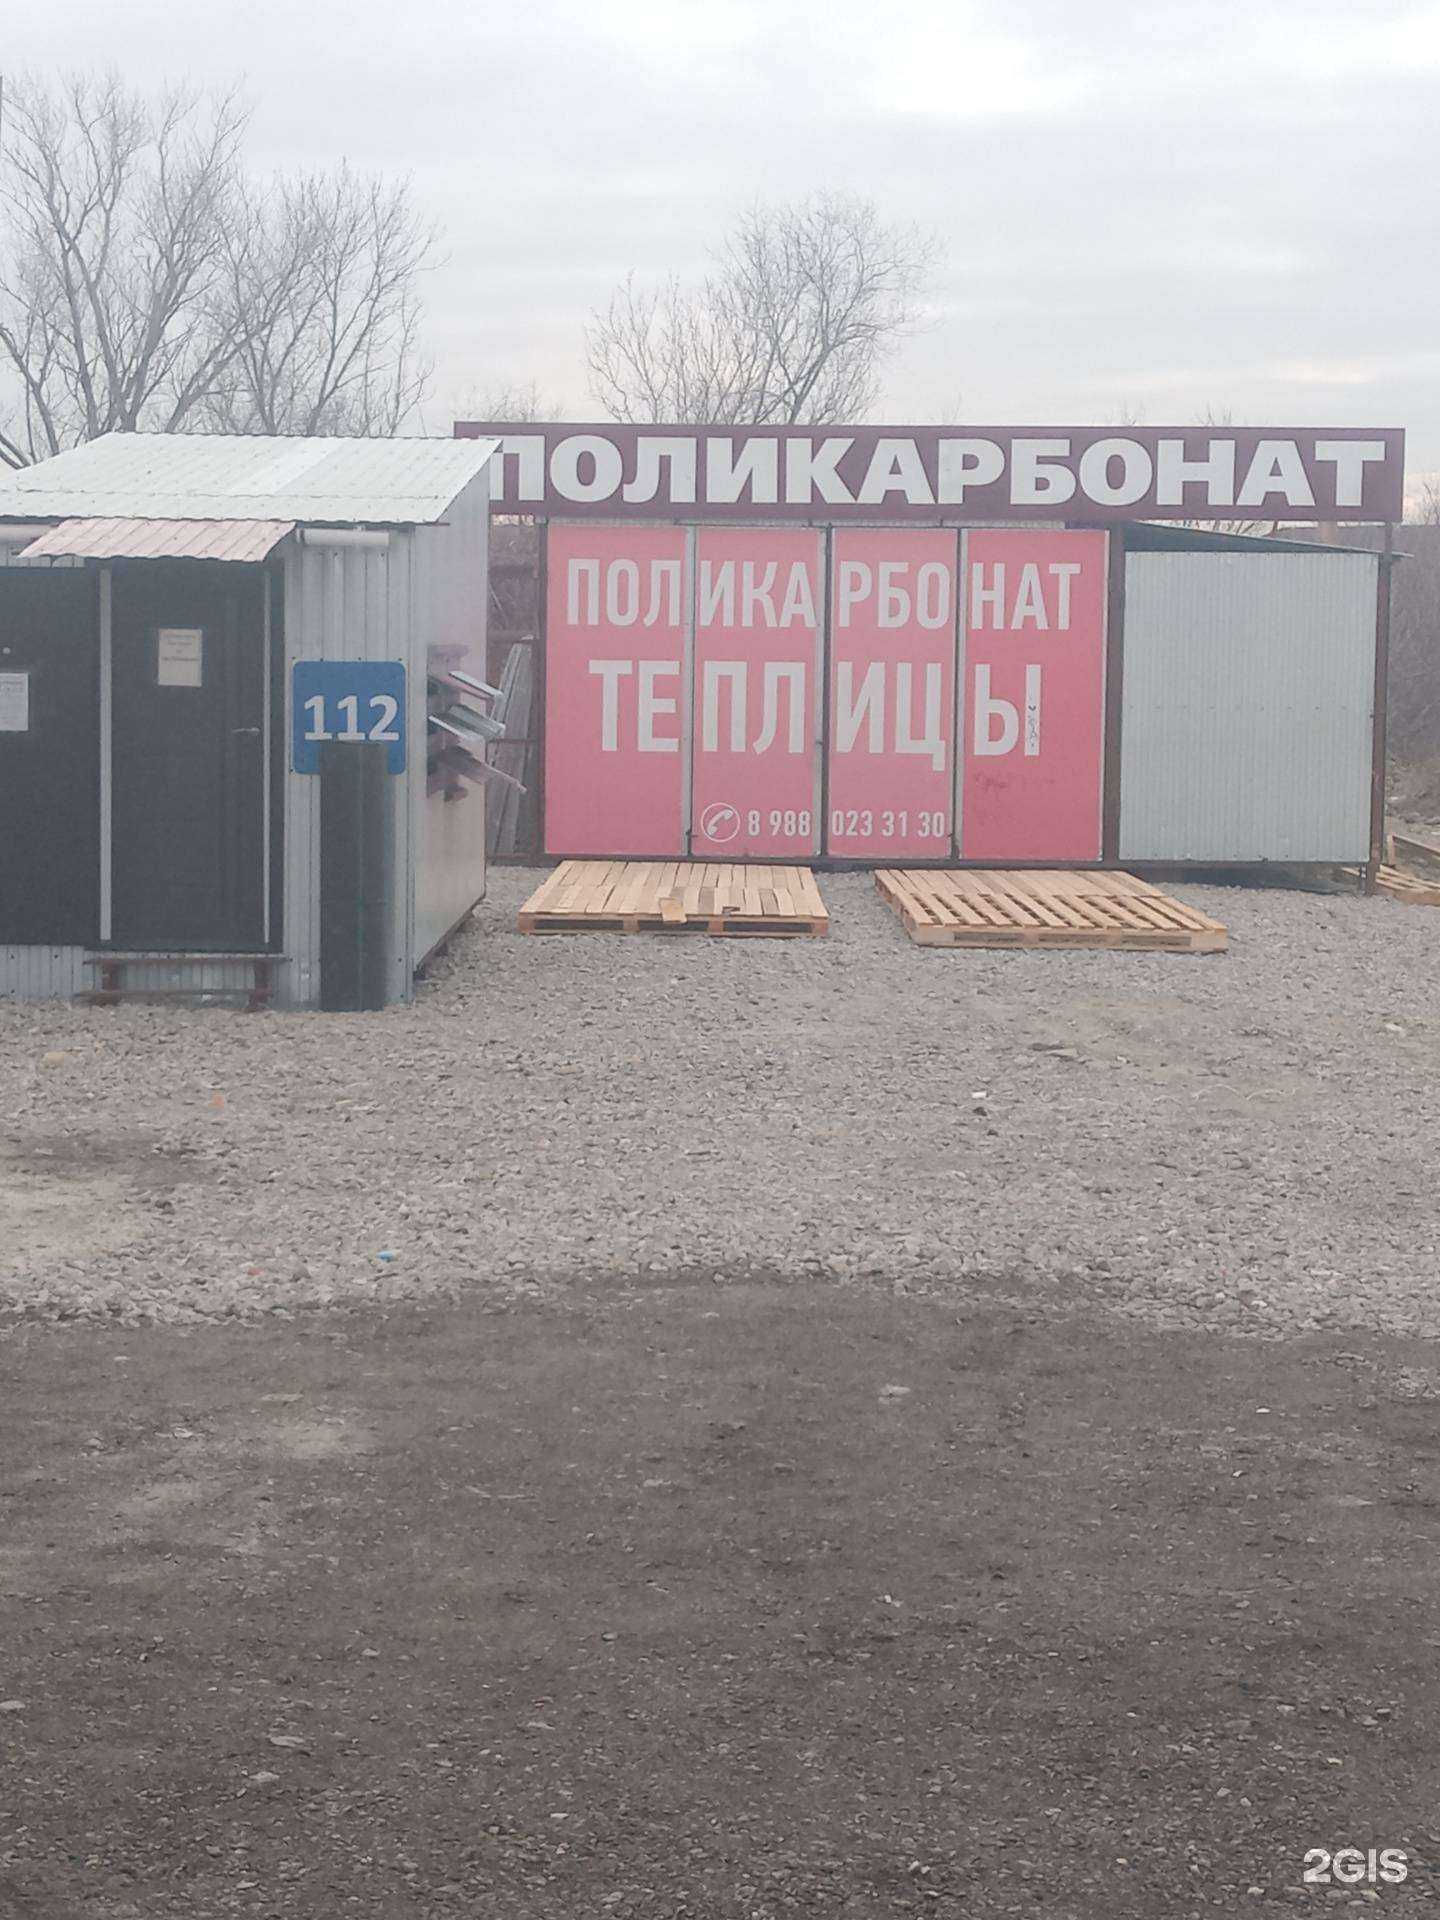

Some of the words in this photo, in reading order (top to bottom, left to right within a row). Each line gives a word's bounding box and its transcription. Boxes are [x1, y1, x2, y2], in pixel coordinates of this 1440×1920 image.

[478, 434, 1386, 508] ПОЛИКАРБОНАТ
[566, 557, 1082, 631] ПОЛИКАРБОНАТ
[304, 694, 400, 741] 112
[588, 659, 1042, 771] ТЕПЛИЦЫ
[748, 810, 760, 836] 8
[769, 810, 812, 836] 988
[832, 810, 873, 837] 023
[881, 811, 909, 837] 31
[917, 811, 945, 838] 30
